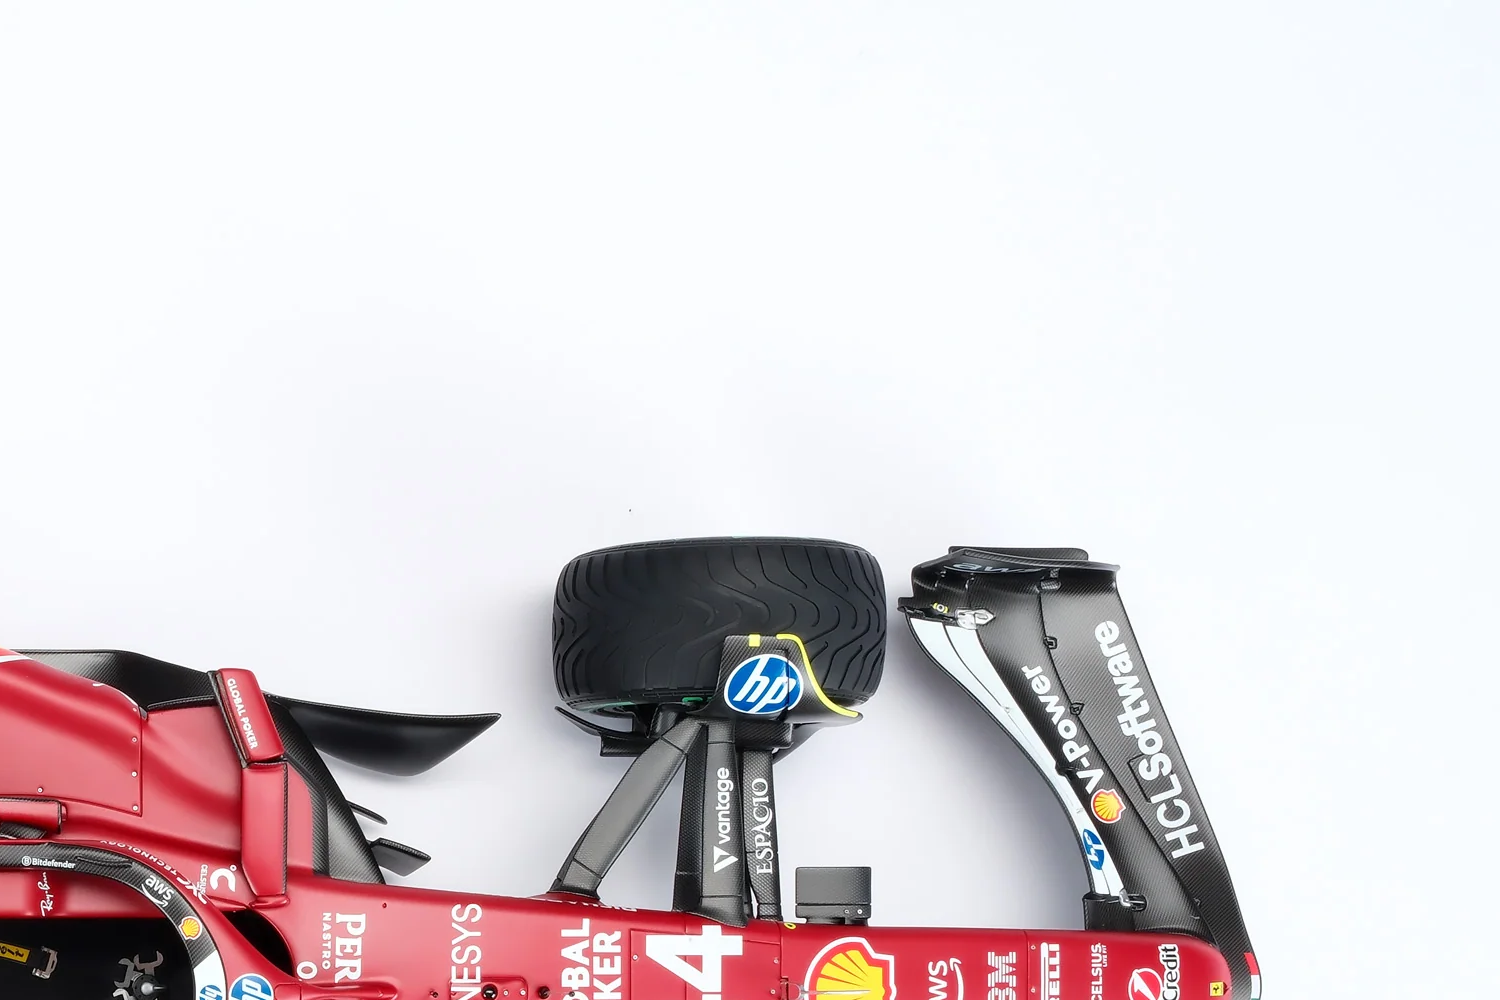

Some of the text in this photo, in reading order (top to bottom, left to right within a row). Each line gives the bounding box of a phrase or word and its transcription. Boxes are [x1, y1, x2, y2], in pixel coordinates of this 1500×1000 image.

[732, 655, 798, 713] hp
[227, 678, 258, 749] GLOBAL POKER
[1020, 664, 1104, 794] V-Power
[1094, 620, 1205, 859] HCLSoftware
[716, 767, 734, 845] vantage
[752, 777, 773, 876] ESPACIO
[32, 858, 76, 869] Bitdefender
[100, 840, 177, 876] TECHNOLOGY
[37, 872, 54, 917] Ray-Ban
[145, 874, 175, 901] aws
[321, 912, 332, 970] NASTRO
